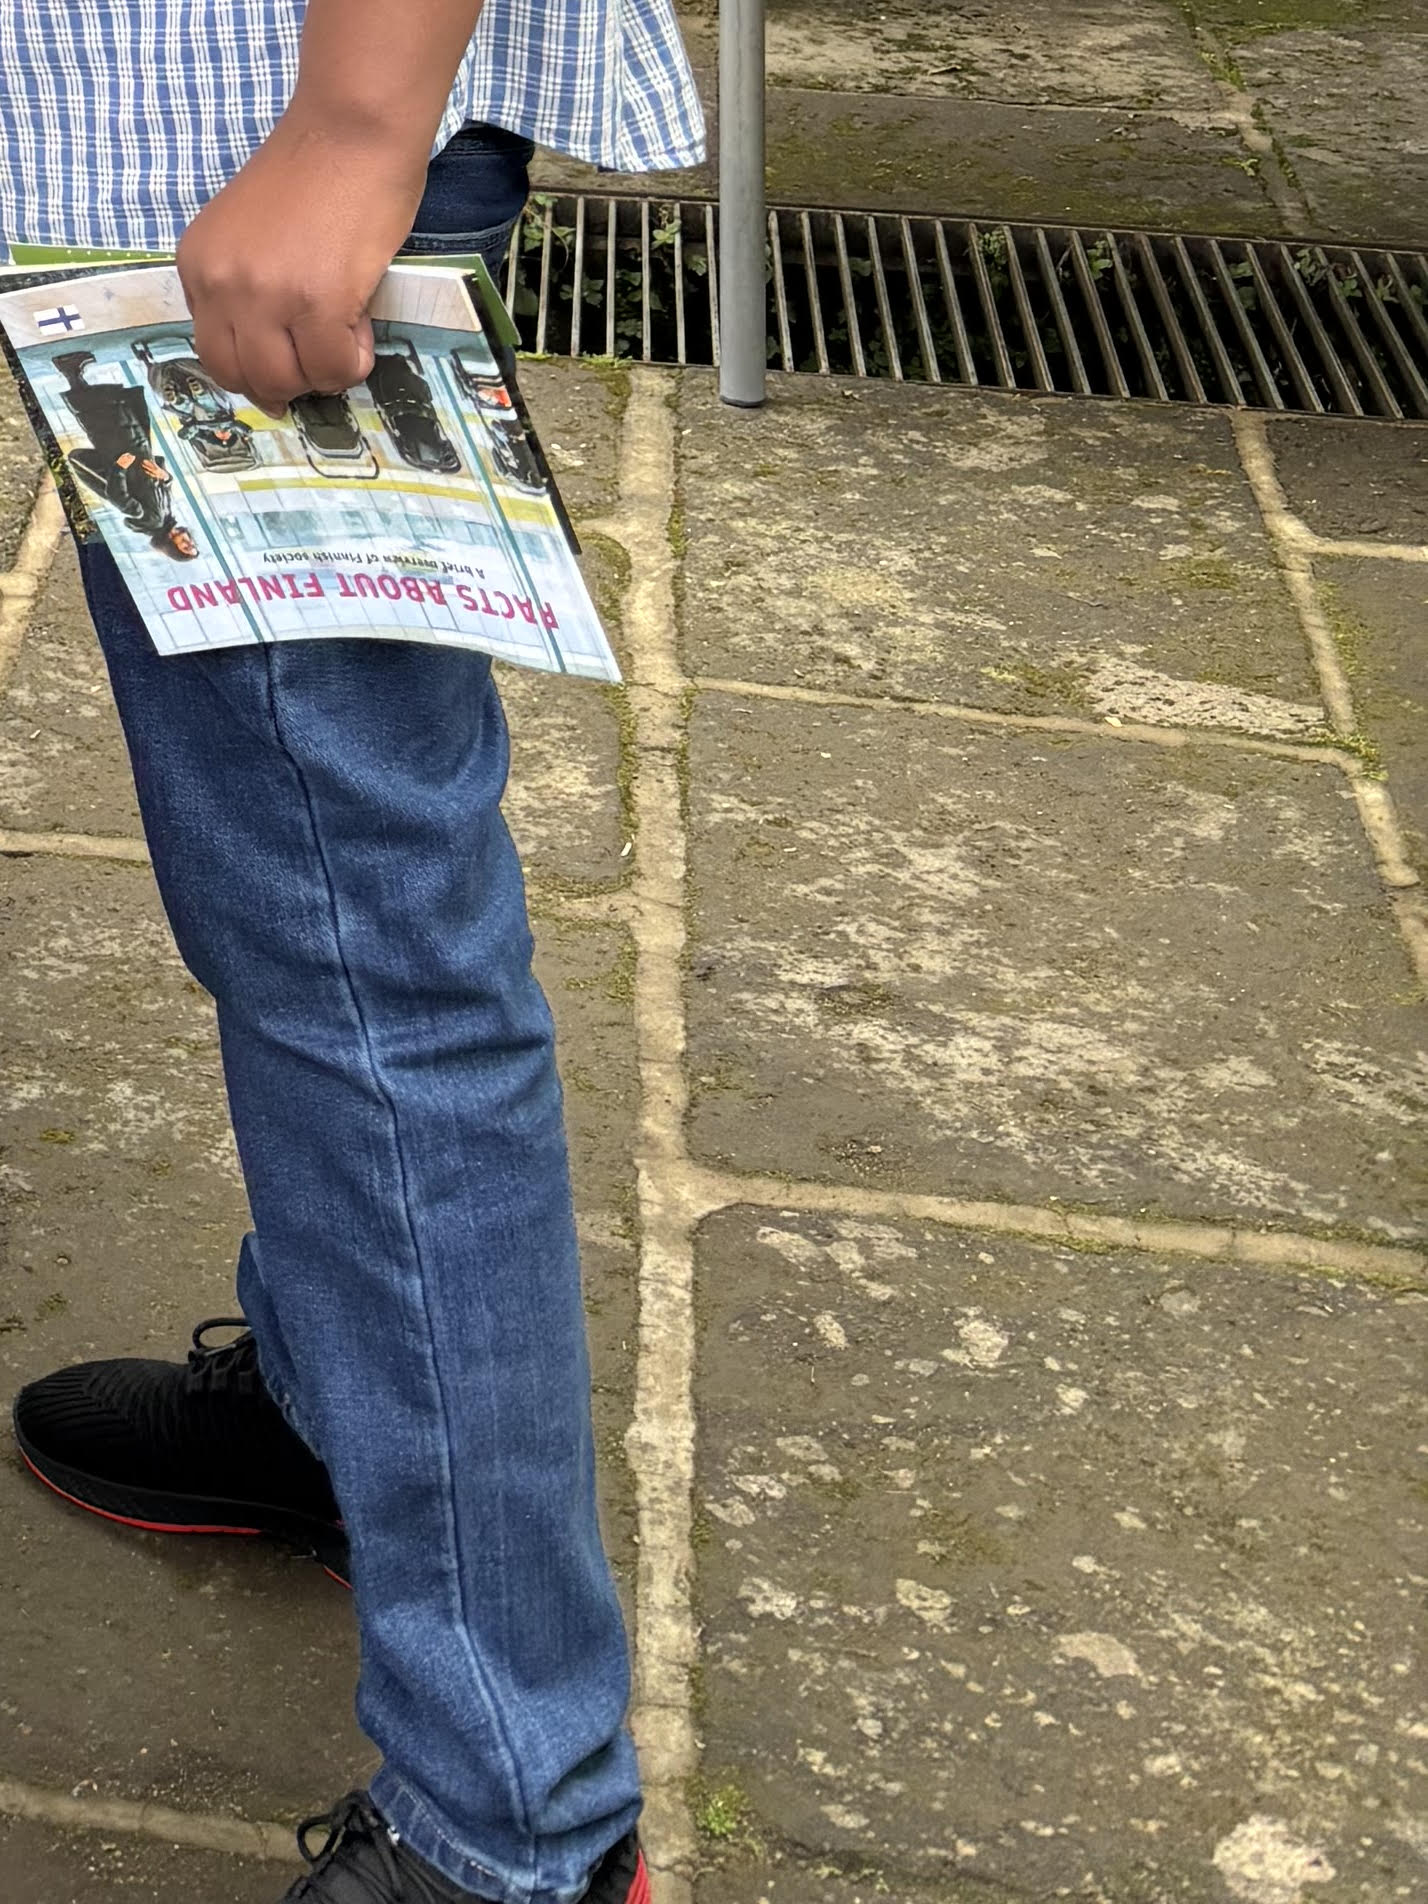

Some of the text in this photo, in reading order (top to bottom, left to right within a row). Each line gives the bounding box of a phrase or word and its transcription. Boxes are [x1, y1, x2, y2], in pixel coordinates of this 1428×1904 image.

[261, 551, 310, 566] society
[313, 551, 363, 566] Finnish
[365, 551, 379, 566] of
[440, 560, 472, 578] brief
[475, 566, 485, 580] A
[167, 572, 559, 630] FACTS ABOUT FINLAND
